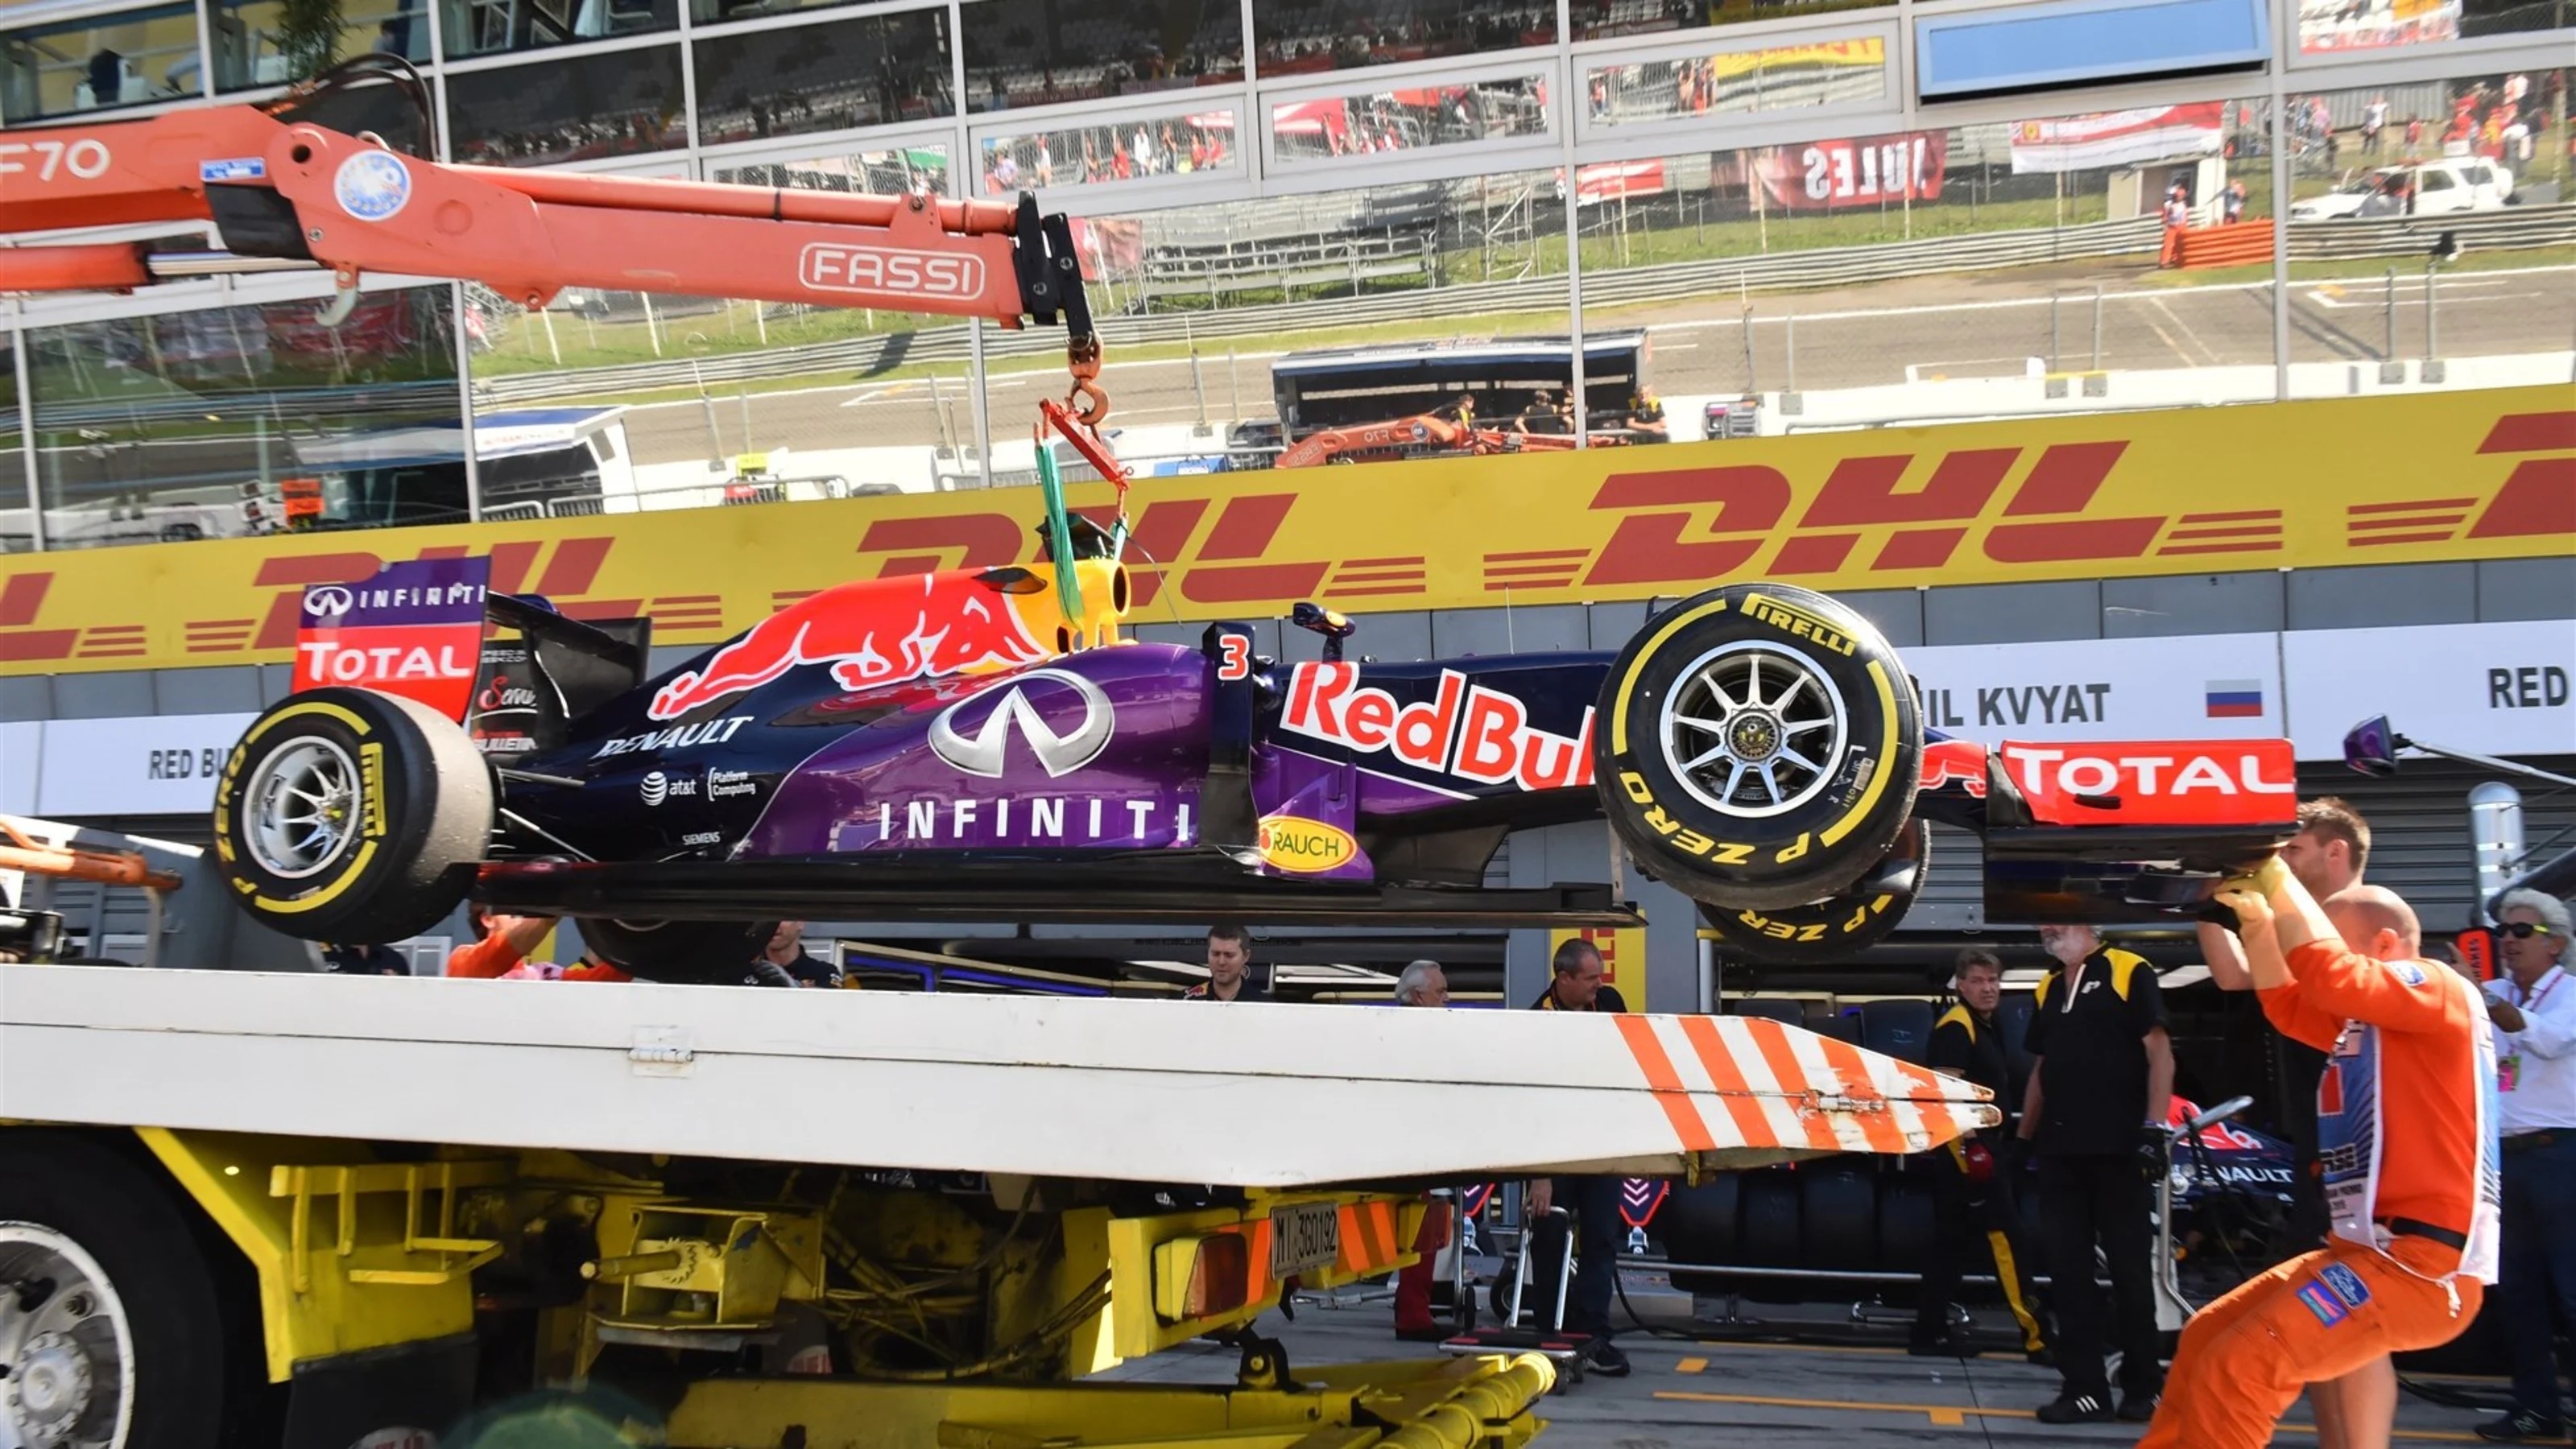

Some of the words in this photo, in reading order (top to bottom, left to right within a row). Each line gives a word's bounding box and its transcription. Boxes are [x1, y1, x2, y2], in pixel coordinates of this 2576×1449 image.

[813, 250, 970, 293] FASSI
[1582, 440, 2166, 585] DHL
[359, 576, 486, 609] INFINITI
[1739, 592, 1859, 657] PIRELLI
[1218, 634, 1250, 680] 3
[1978, 683, 2111, 727] KVYAT
[2489, 667, 2569, 708] RED
[589, 716, 755, 760] RENAULT
[148, 748, 193, 779] RED
[713, 770, 749, 783] Platform
[2006, 749, 2296, 796] TOTAL
[213, 744, 246, 862] ZERO
[359, 742, 387, 837] PIRELLI
[668, 778, 697, 795] at&t
[713, 782, 756, 797] Computing
[681, 831, 721, 846] SIEMENS
[879, 798, 1189, 841] INFINITI
[1619, 771, 1755, 865] ZERO
[1272, 830, 1339, 857] RAUCH
[1776, 832, 1810, 864] P
[1738, 908, 1829, 942] ZER
[1843, 905, 1866, 932] P
[1276, 1216, 1291, 1264] MI
